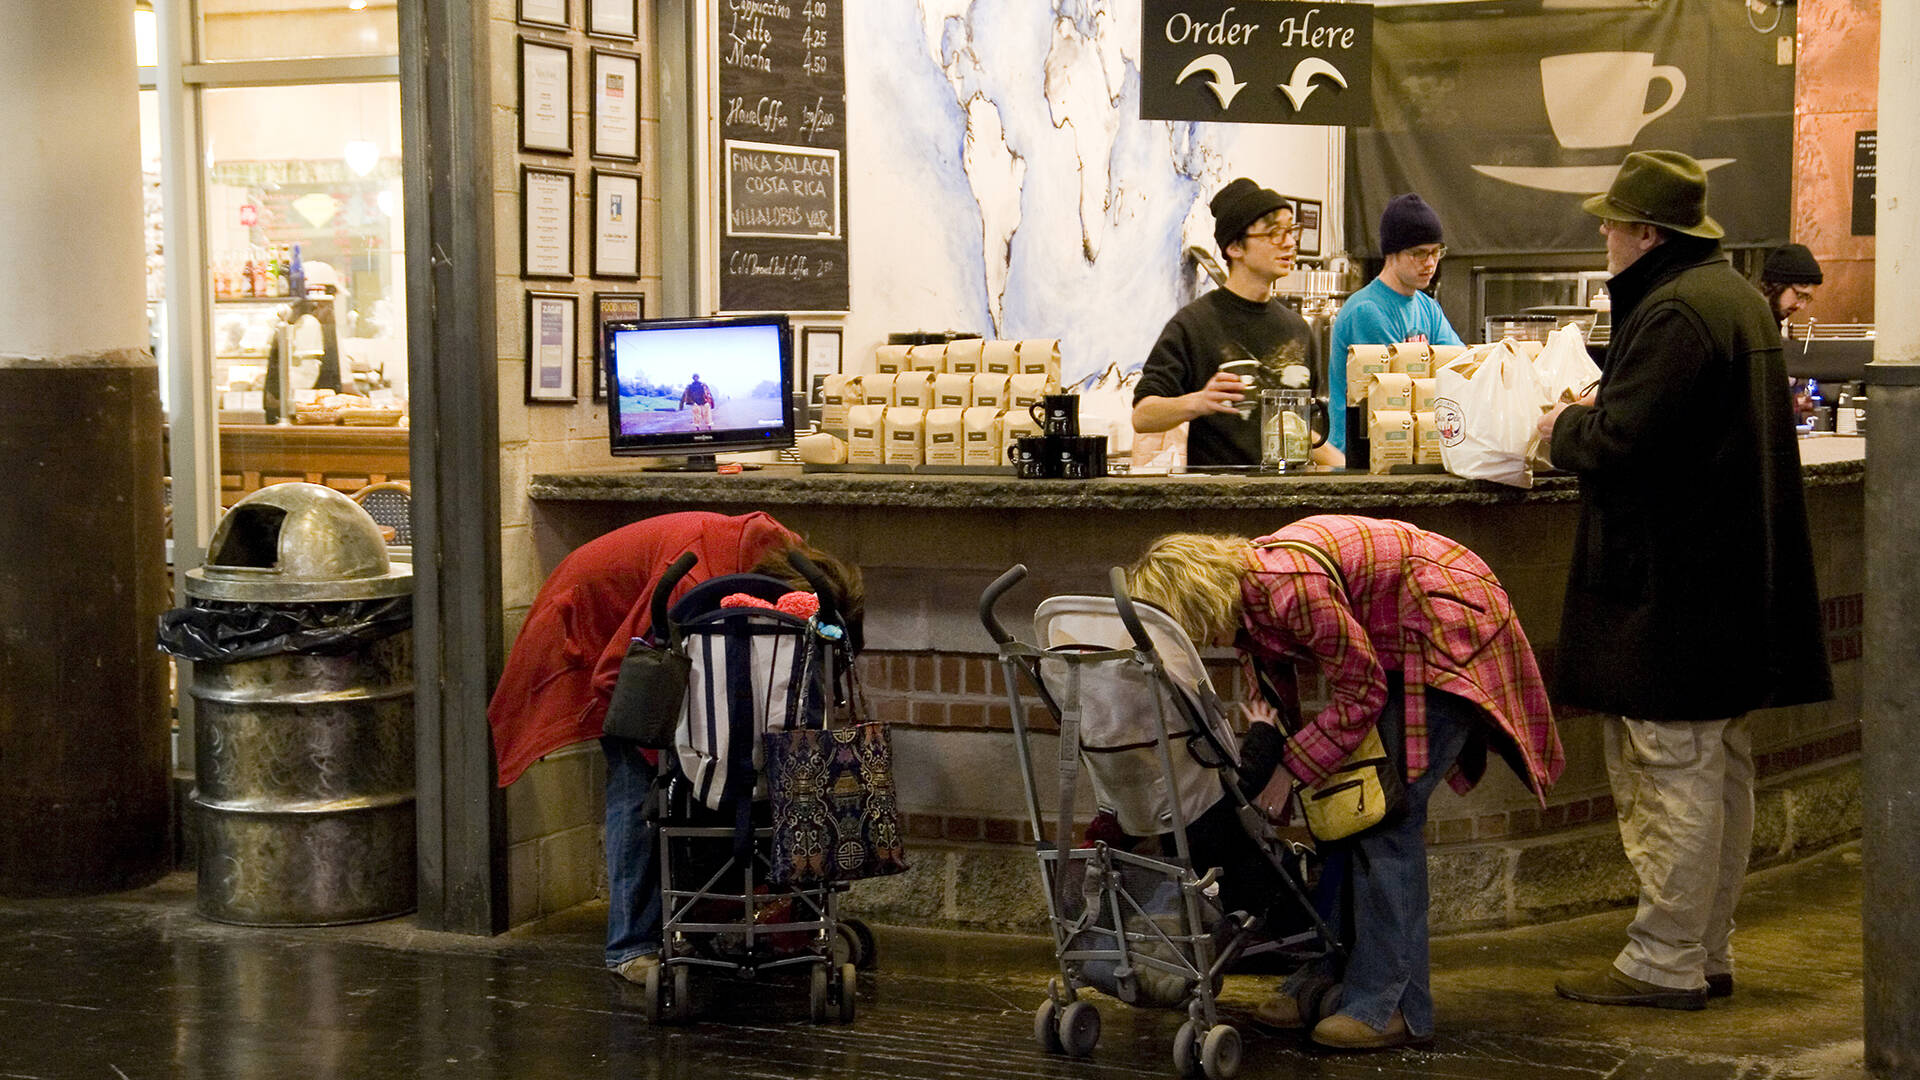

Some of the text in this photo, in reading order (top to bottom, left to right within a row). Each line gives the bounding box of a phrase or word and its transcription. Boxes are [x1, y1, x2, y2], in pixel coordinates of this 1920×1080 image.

[802, 0, 827, 22] 4.00
[728, 11, 827, 49] Latte 4.25
[1165, 7, 1355, 49] Order Here
[726, 41, 827, 76] Mocha 4.50
[732, 152, 832, 176] FINCA SALACA
[745, 176, 826, 198] COSTA RICA
[600, 302, 617, 312] FOOD
